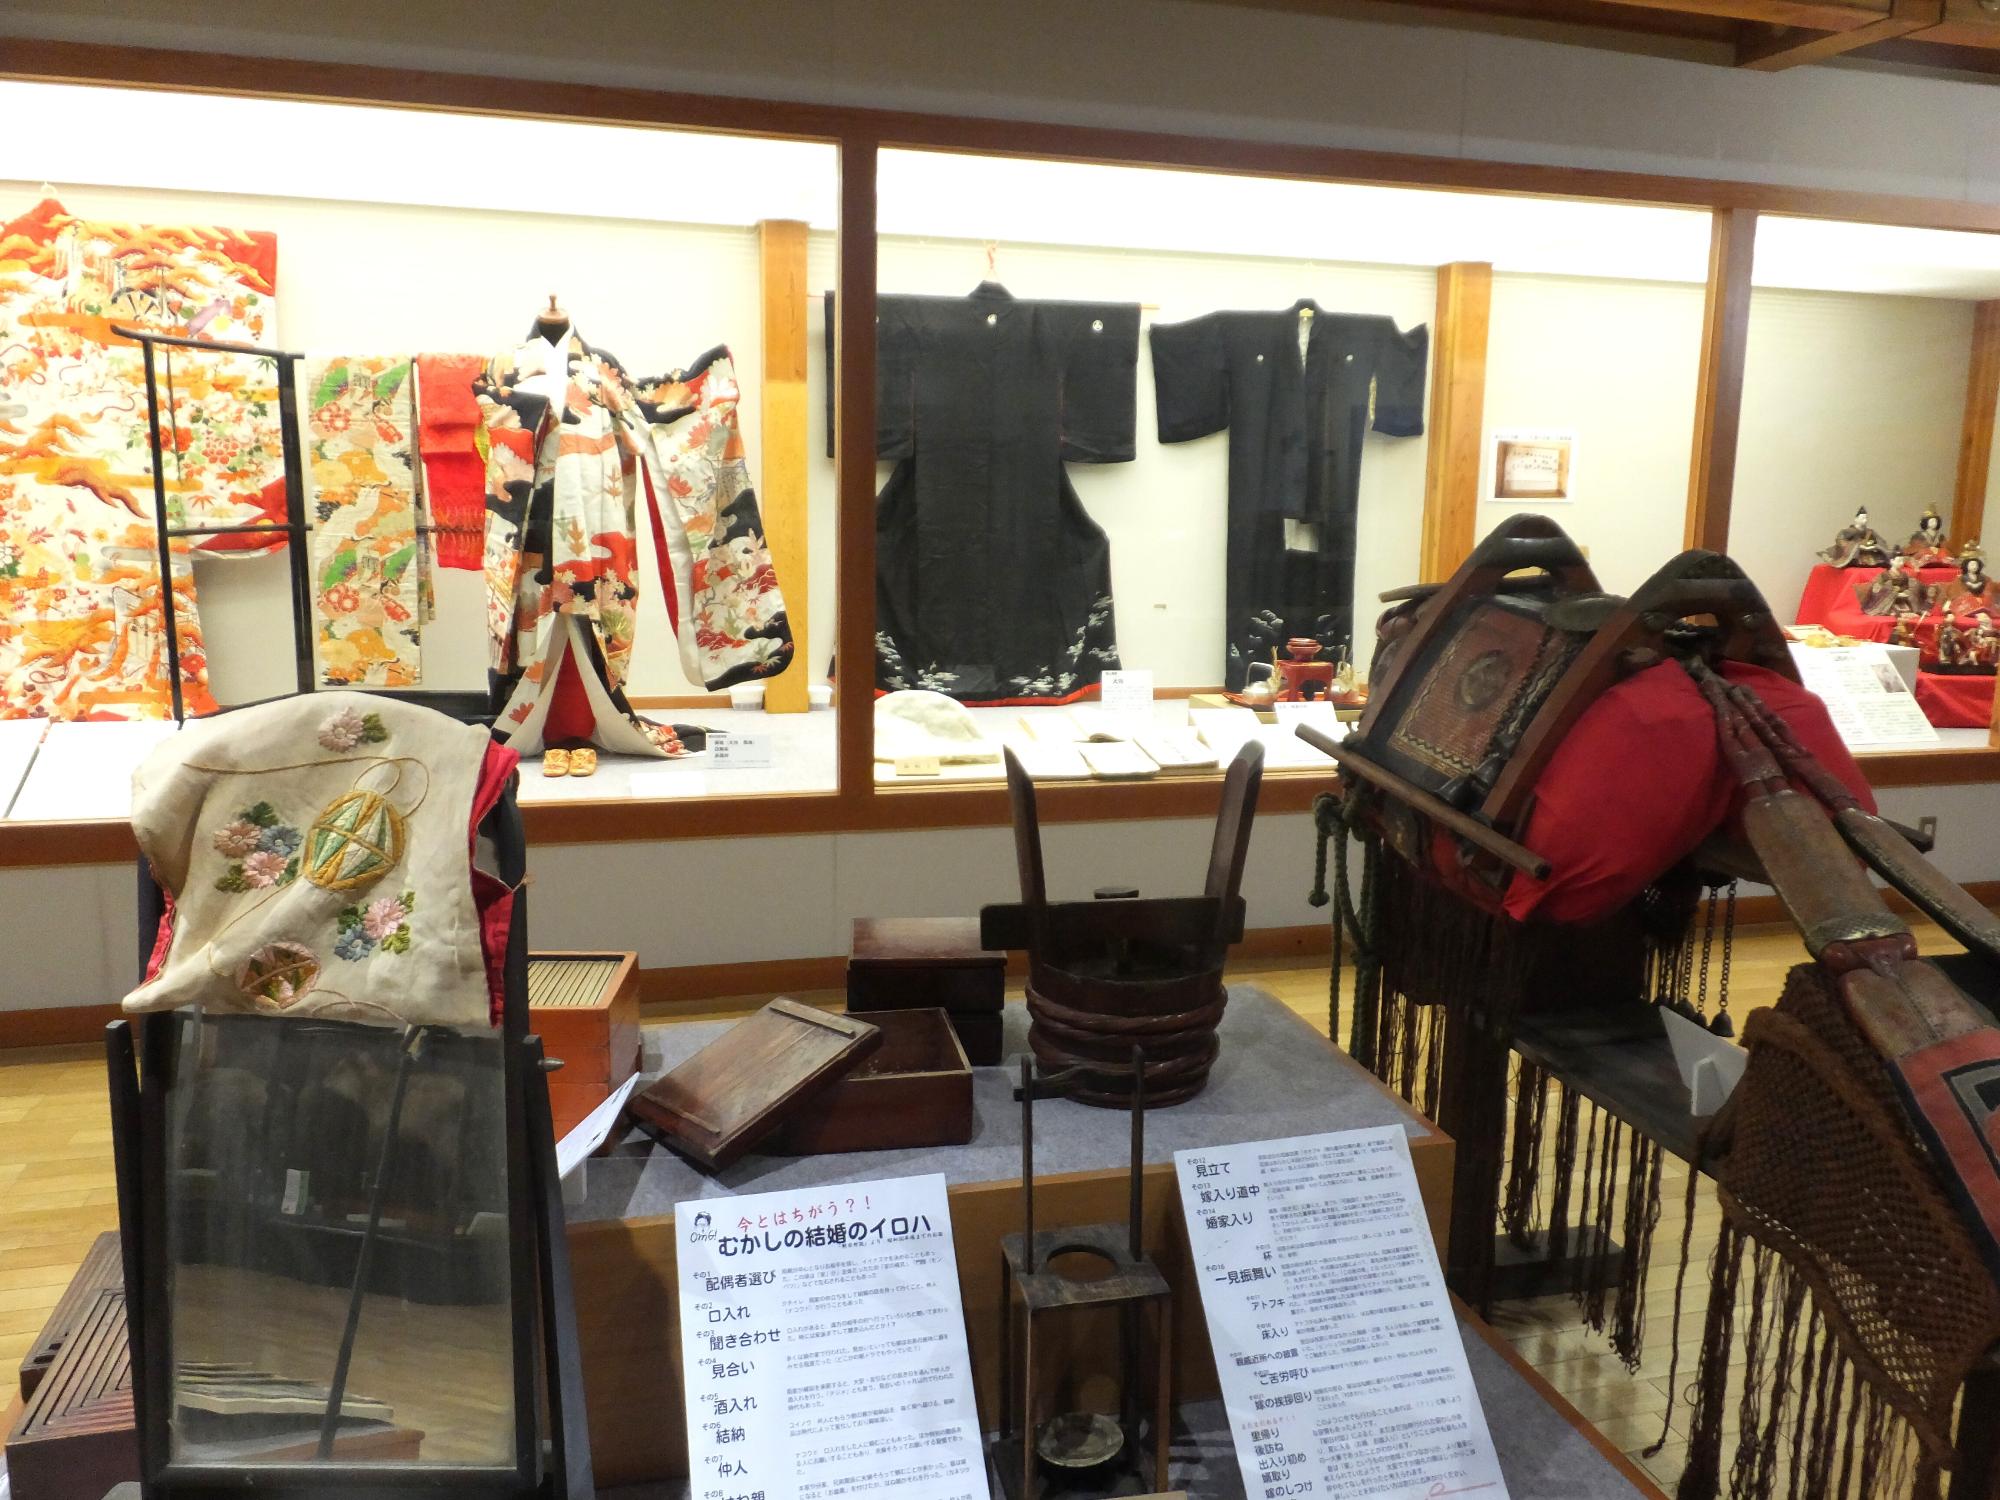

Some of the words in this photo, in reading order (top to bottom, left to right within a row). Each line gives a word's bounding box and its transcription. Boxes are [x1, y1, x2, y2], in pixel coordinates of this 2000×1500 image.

[1195, 1162, 1230, 1178] 見立て
[1200, 1185, 1260, 1203] 嫁入り道中
[1205, 1211, 1253, 1230] 婚家入り
[718, 1214, 932, 1257] むかしの結婚のイロハ
[706, 1268, 777, 1292] 配偶者選び
[1215, 1265, 1277, 1285] 一見振舞い
[694, 1302, 713, 1311] その2
[708, 1306, 751, 1323] 口入れ
[709, 1328, 781, 1351] 聞き合わせ
[712, 1361, 755, 1380] 見合い
[714, 1395, 758, 1416] 酒入れ
[716, 1426, 746, 1445] 結納
[718, 1459, 749, 1479] 仲人
[1264, 1480, 1313, 1499] 嫁のしつけ
